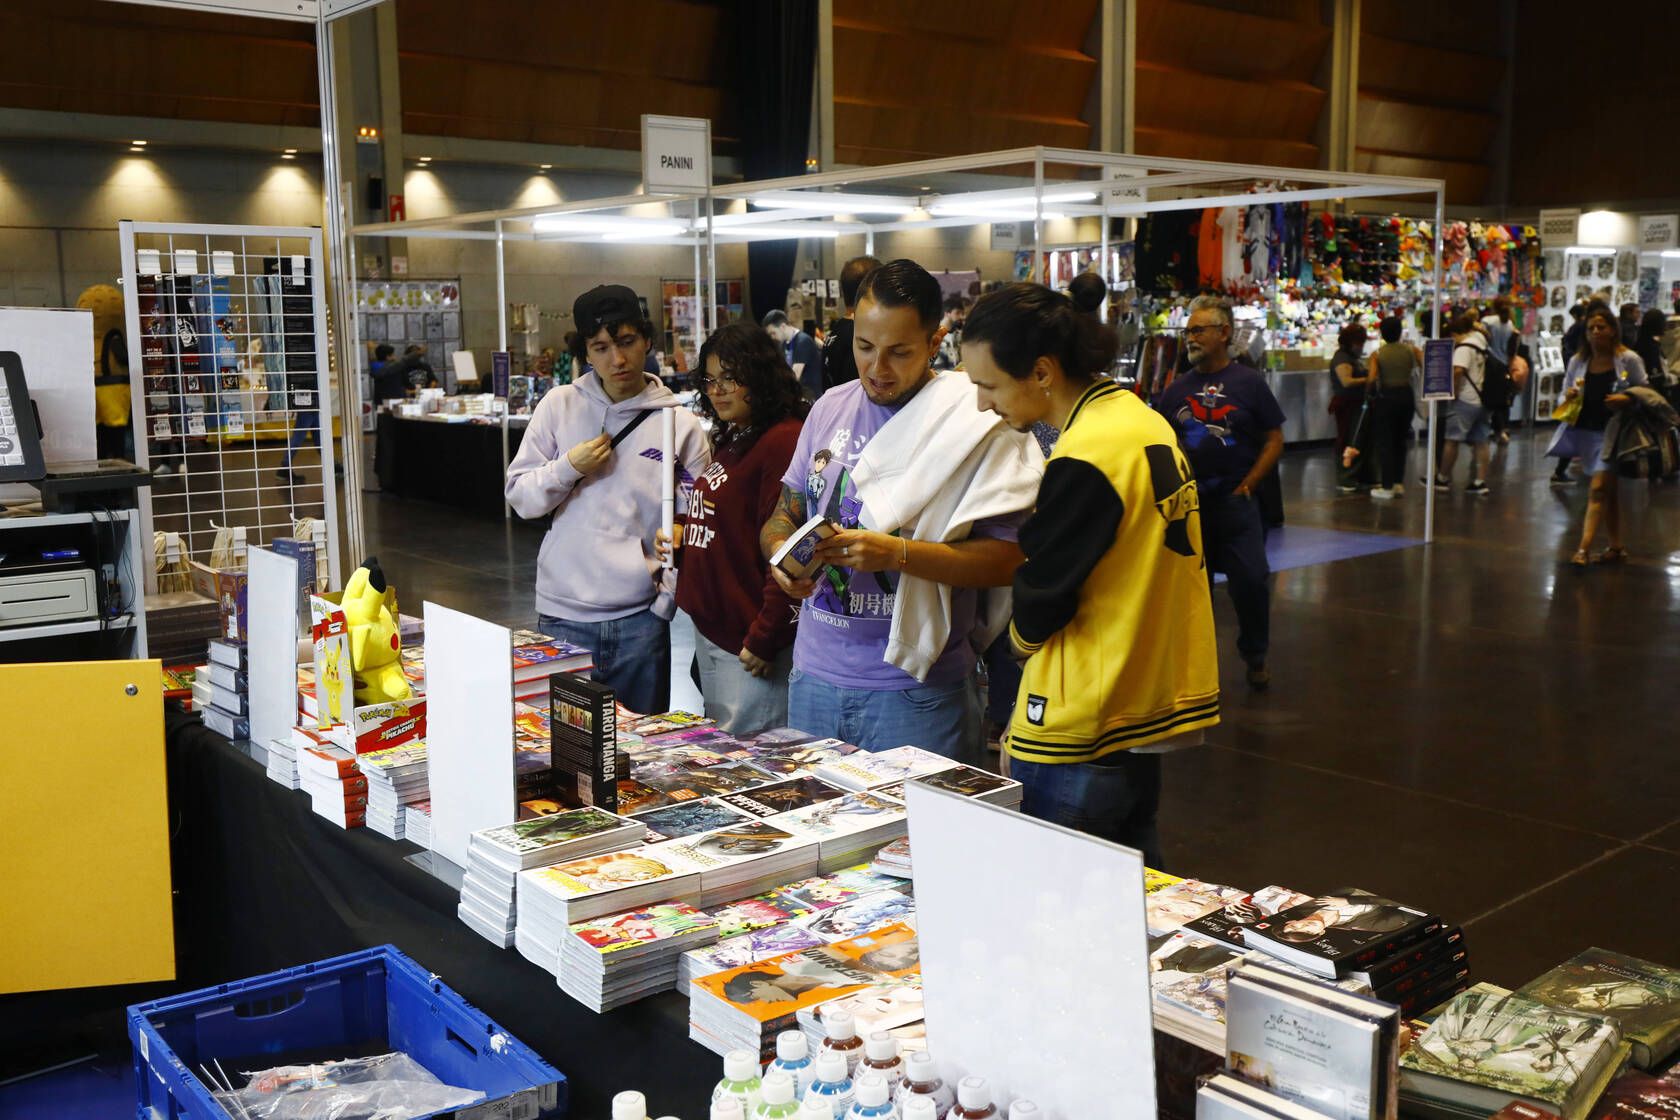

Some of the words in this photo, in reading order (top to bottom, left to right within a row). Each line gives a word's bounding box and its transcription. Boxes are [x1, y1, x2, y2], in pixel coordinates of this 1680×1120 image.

[660, 154, 694, 170] PANINI
[811, 610, 850, 630] EVANGELION
[602, 699, 615, 740] TAROT
[385, 723, 415, 741] PIKACHU
[602, 740, 616, 783] MANGA
